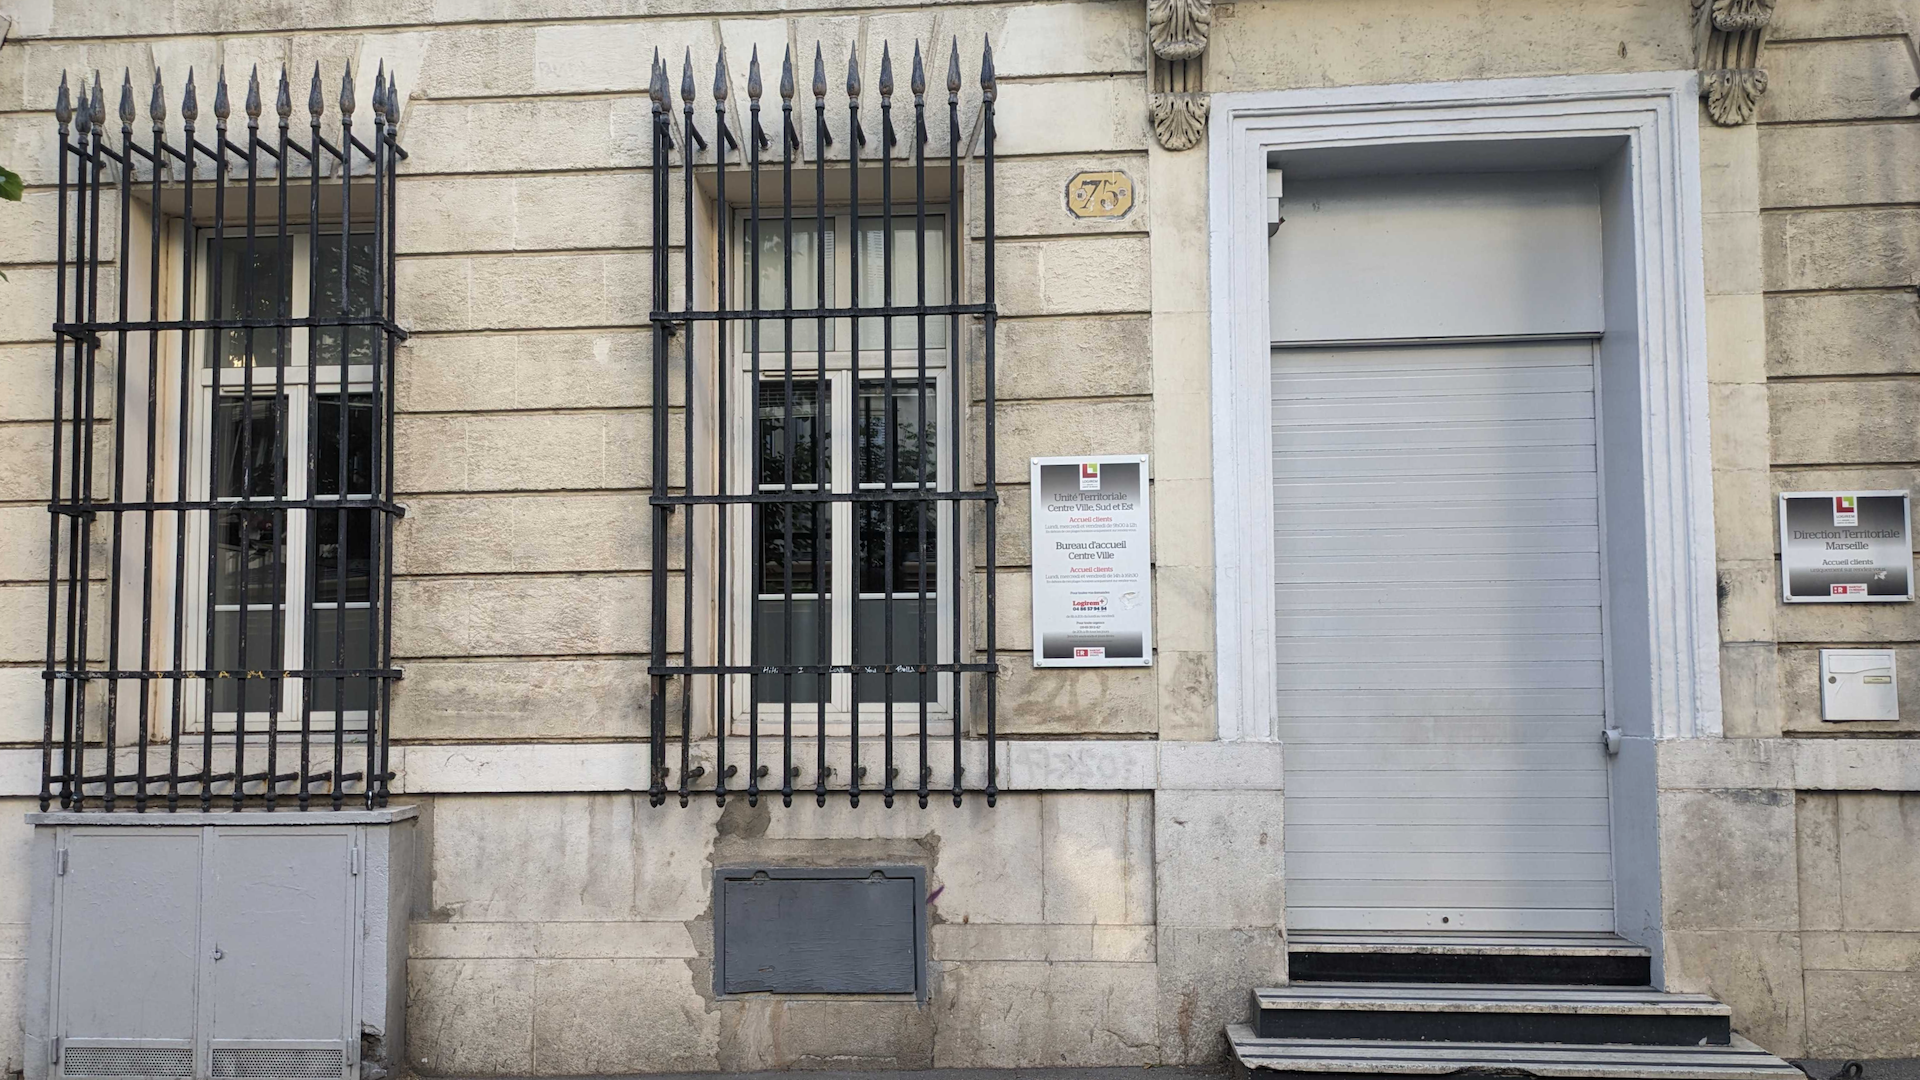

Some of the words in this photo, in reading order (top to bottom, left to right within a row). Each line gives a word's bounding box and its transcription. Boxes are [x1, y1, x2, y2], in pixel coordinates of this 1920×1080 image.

[1080, 180, 1119, 210] 75
[1054, 493, 1078, 502] Unité
[1078, 492, 1127, 501] Territoriale
[1048, 504, 1075, 512] Centre
[1076, 503, 1095, 512] Ville,
[1096, 503, 1111, 511] Sud
[1794, 530, 1841, 539] Direction
[1842, 529, 1900, 539] Territoriale
[1056, 541, 1087, 550] Bureau
[1088, 540, 1127, 549] d'accueil
[1825, 542, 1869, 550] Marseille
